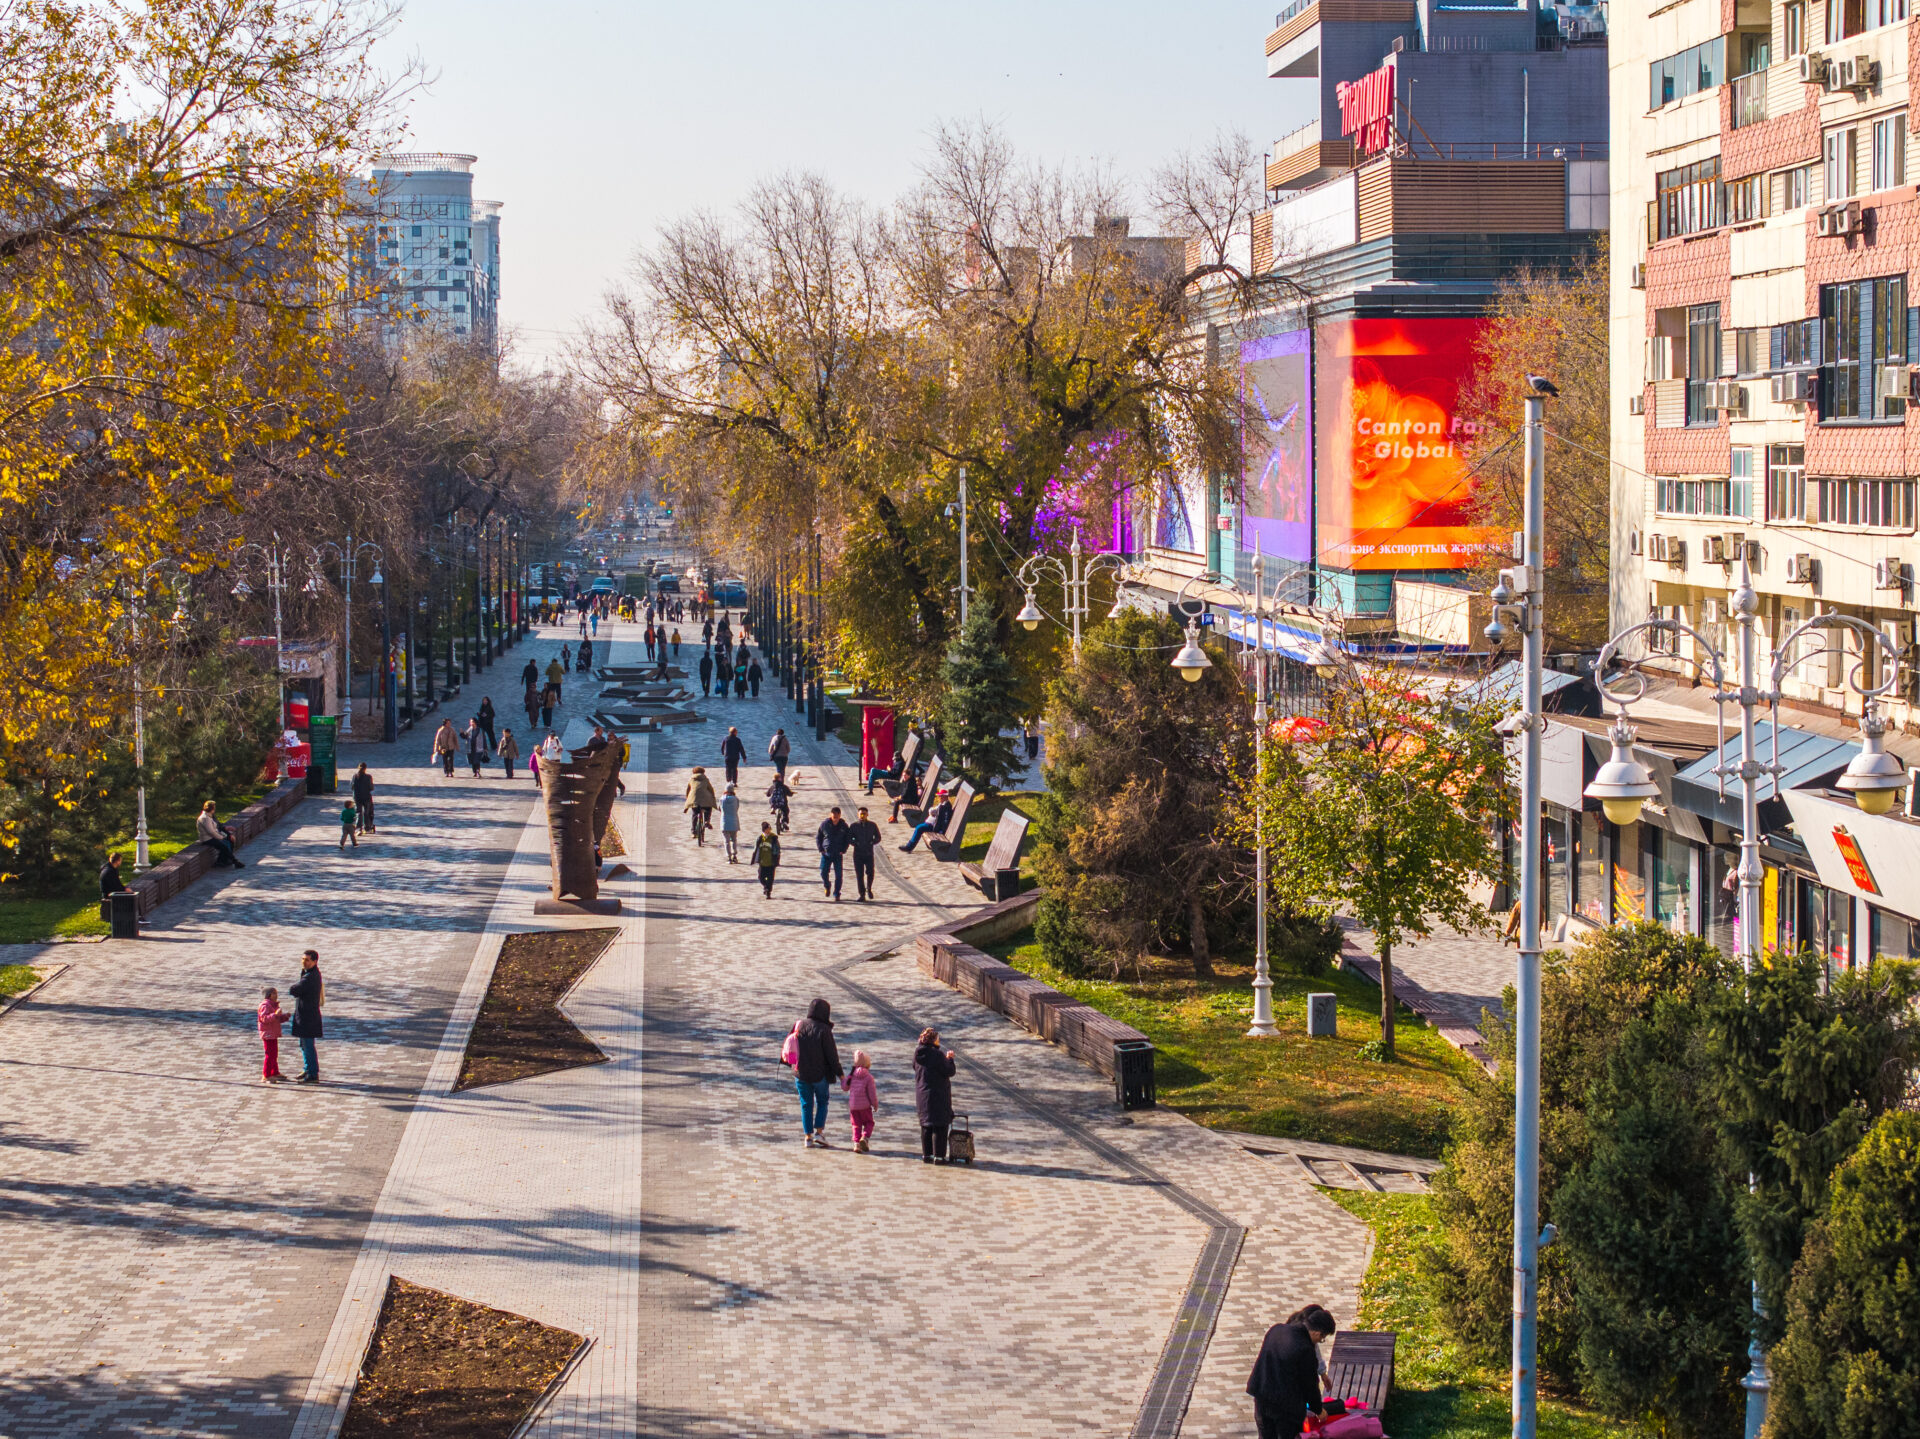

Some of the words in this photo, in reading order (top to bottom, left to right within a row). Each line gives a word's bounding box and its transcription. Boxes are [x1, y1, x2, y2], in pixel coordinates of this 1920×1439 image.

[1357, 417, 1441, 435] Canton
[1374, 441, 1454, 459] Global
[1378, 543, 1449, 557] экспорттық
